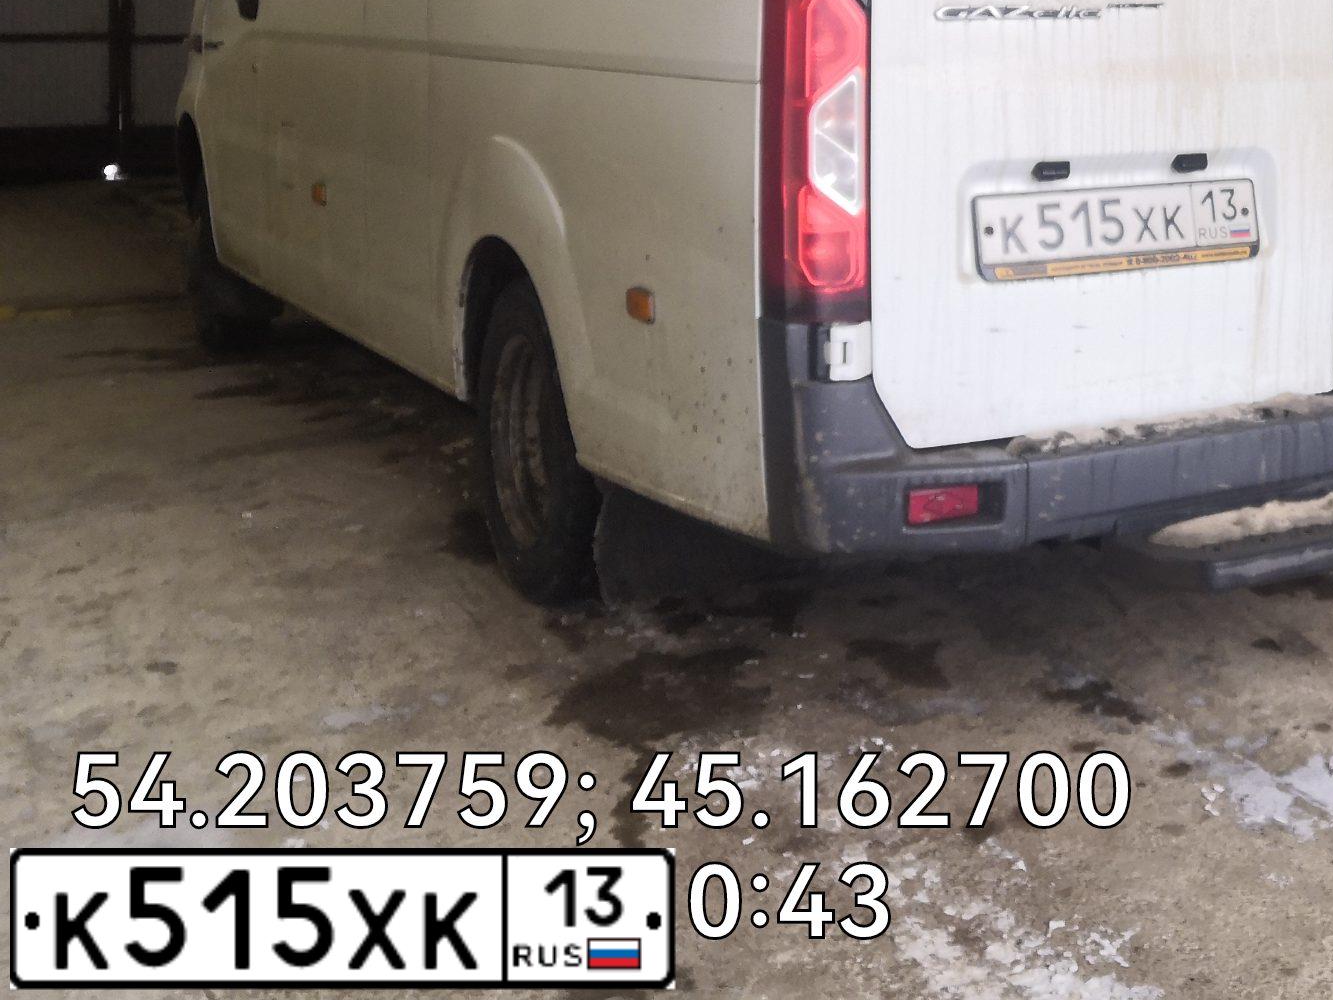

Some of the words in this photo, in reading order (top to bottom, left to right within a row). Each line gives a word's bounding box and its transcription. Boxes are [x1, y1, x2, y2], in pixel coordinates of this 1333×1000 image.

[1000, 197, 1185, 255] К515ХК
[1201, 188, 1238, 223] 13
[1197, 224, 1229, 240] RUS
